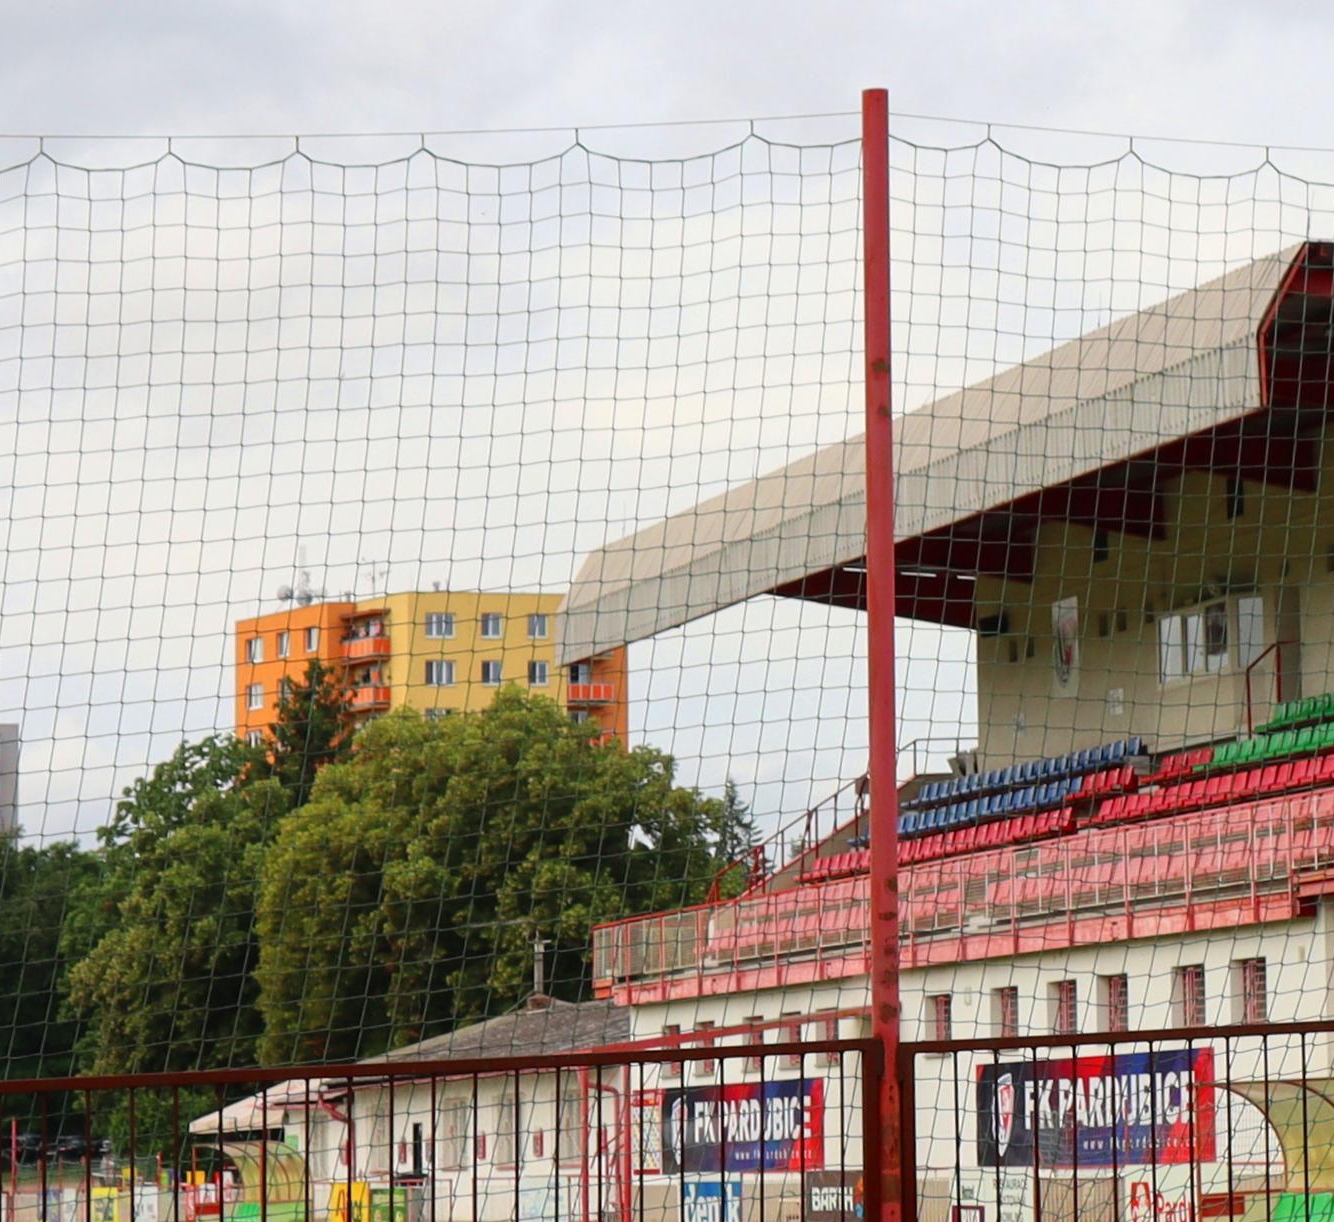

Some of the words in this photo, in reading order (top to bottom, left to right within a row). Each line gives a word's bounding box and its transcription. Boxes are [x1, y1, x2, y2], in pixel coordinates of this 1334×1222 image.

[694, 1101, 717, 1144] FK
[717, 1095, 812, 1144] PARDUBICE
[1025, 1080, 1055, 1130] FK
[1058, 1070, 1196, 1129] PARDUBICE
